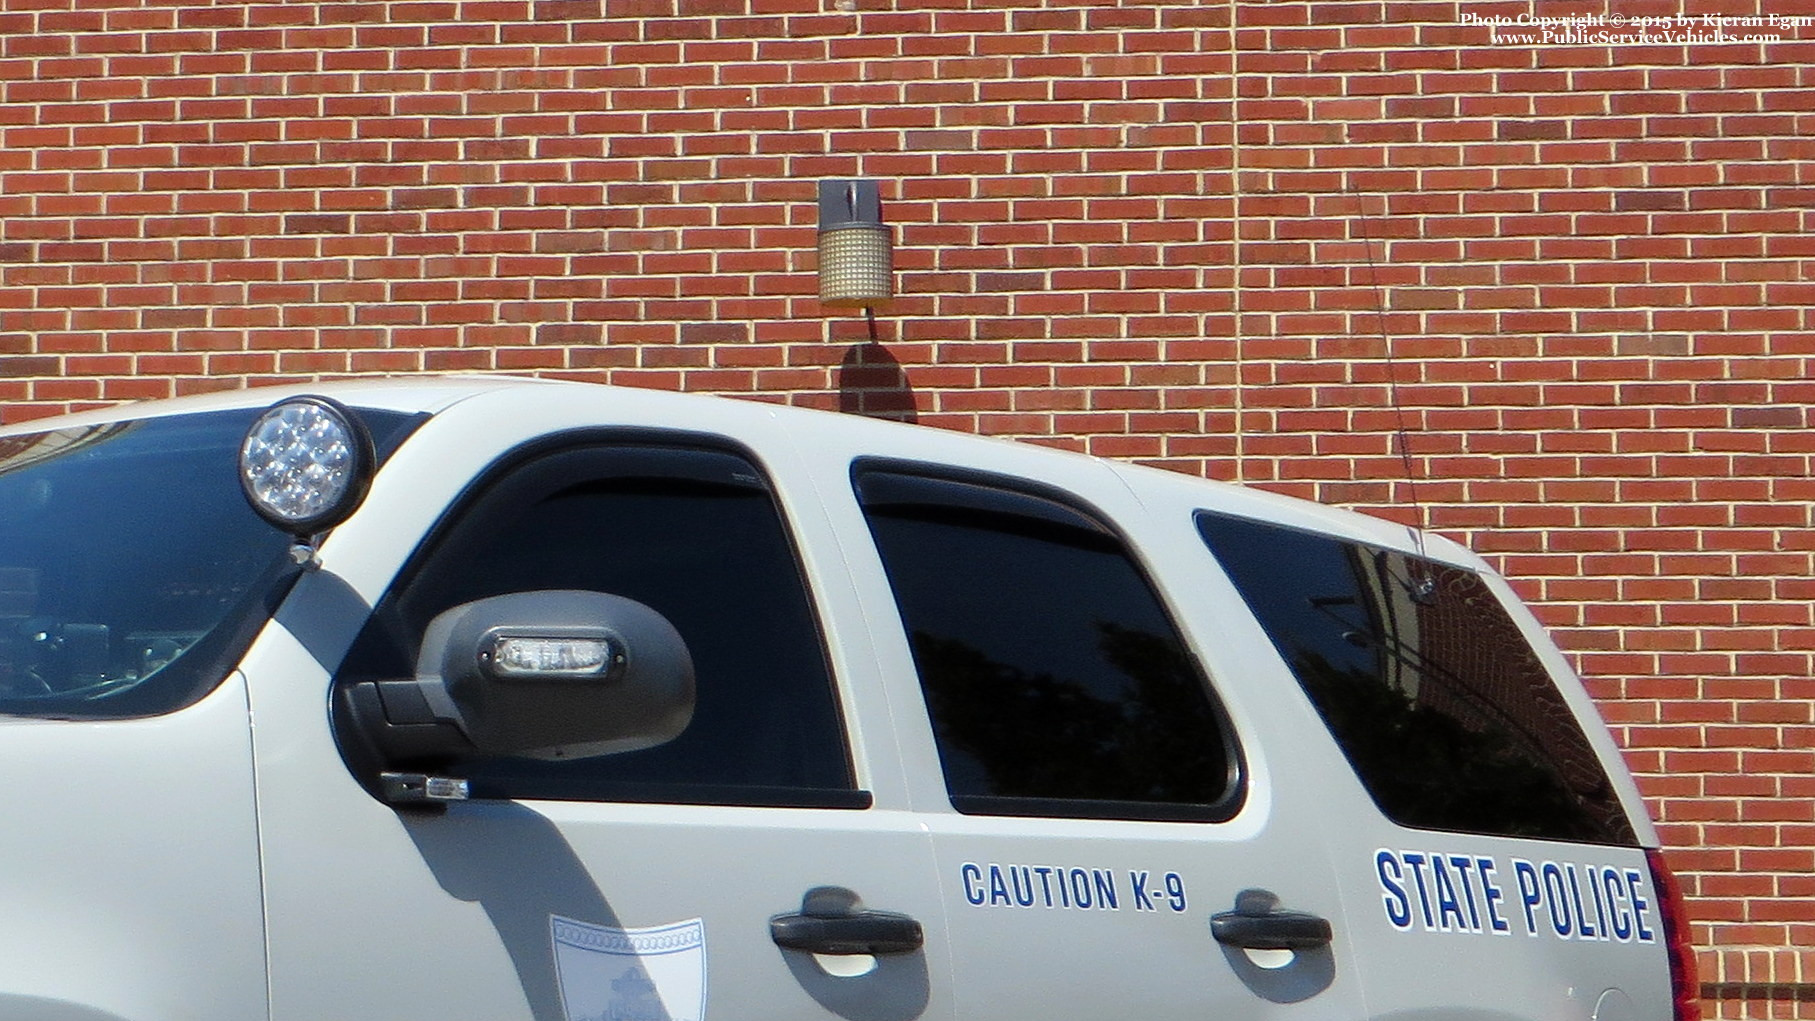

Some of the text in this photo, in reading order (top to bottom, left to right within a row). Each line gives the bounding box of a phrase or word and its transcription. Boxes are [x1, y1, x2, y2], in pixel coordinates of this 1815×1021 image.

[960, 861, 1187, 914] CAUTION K-9
[1373, 846, 1656, 945] STATE POLICE
